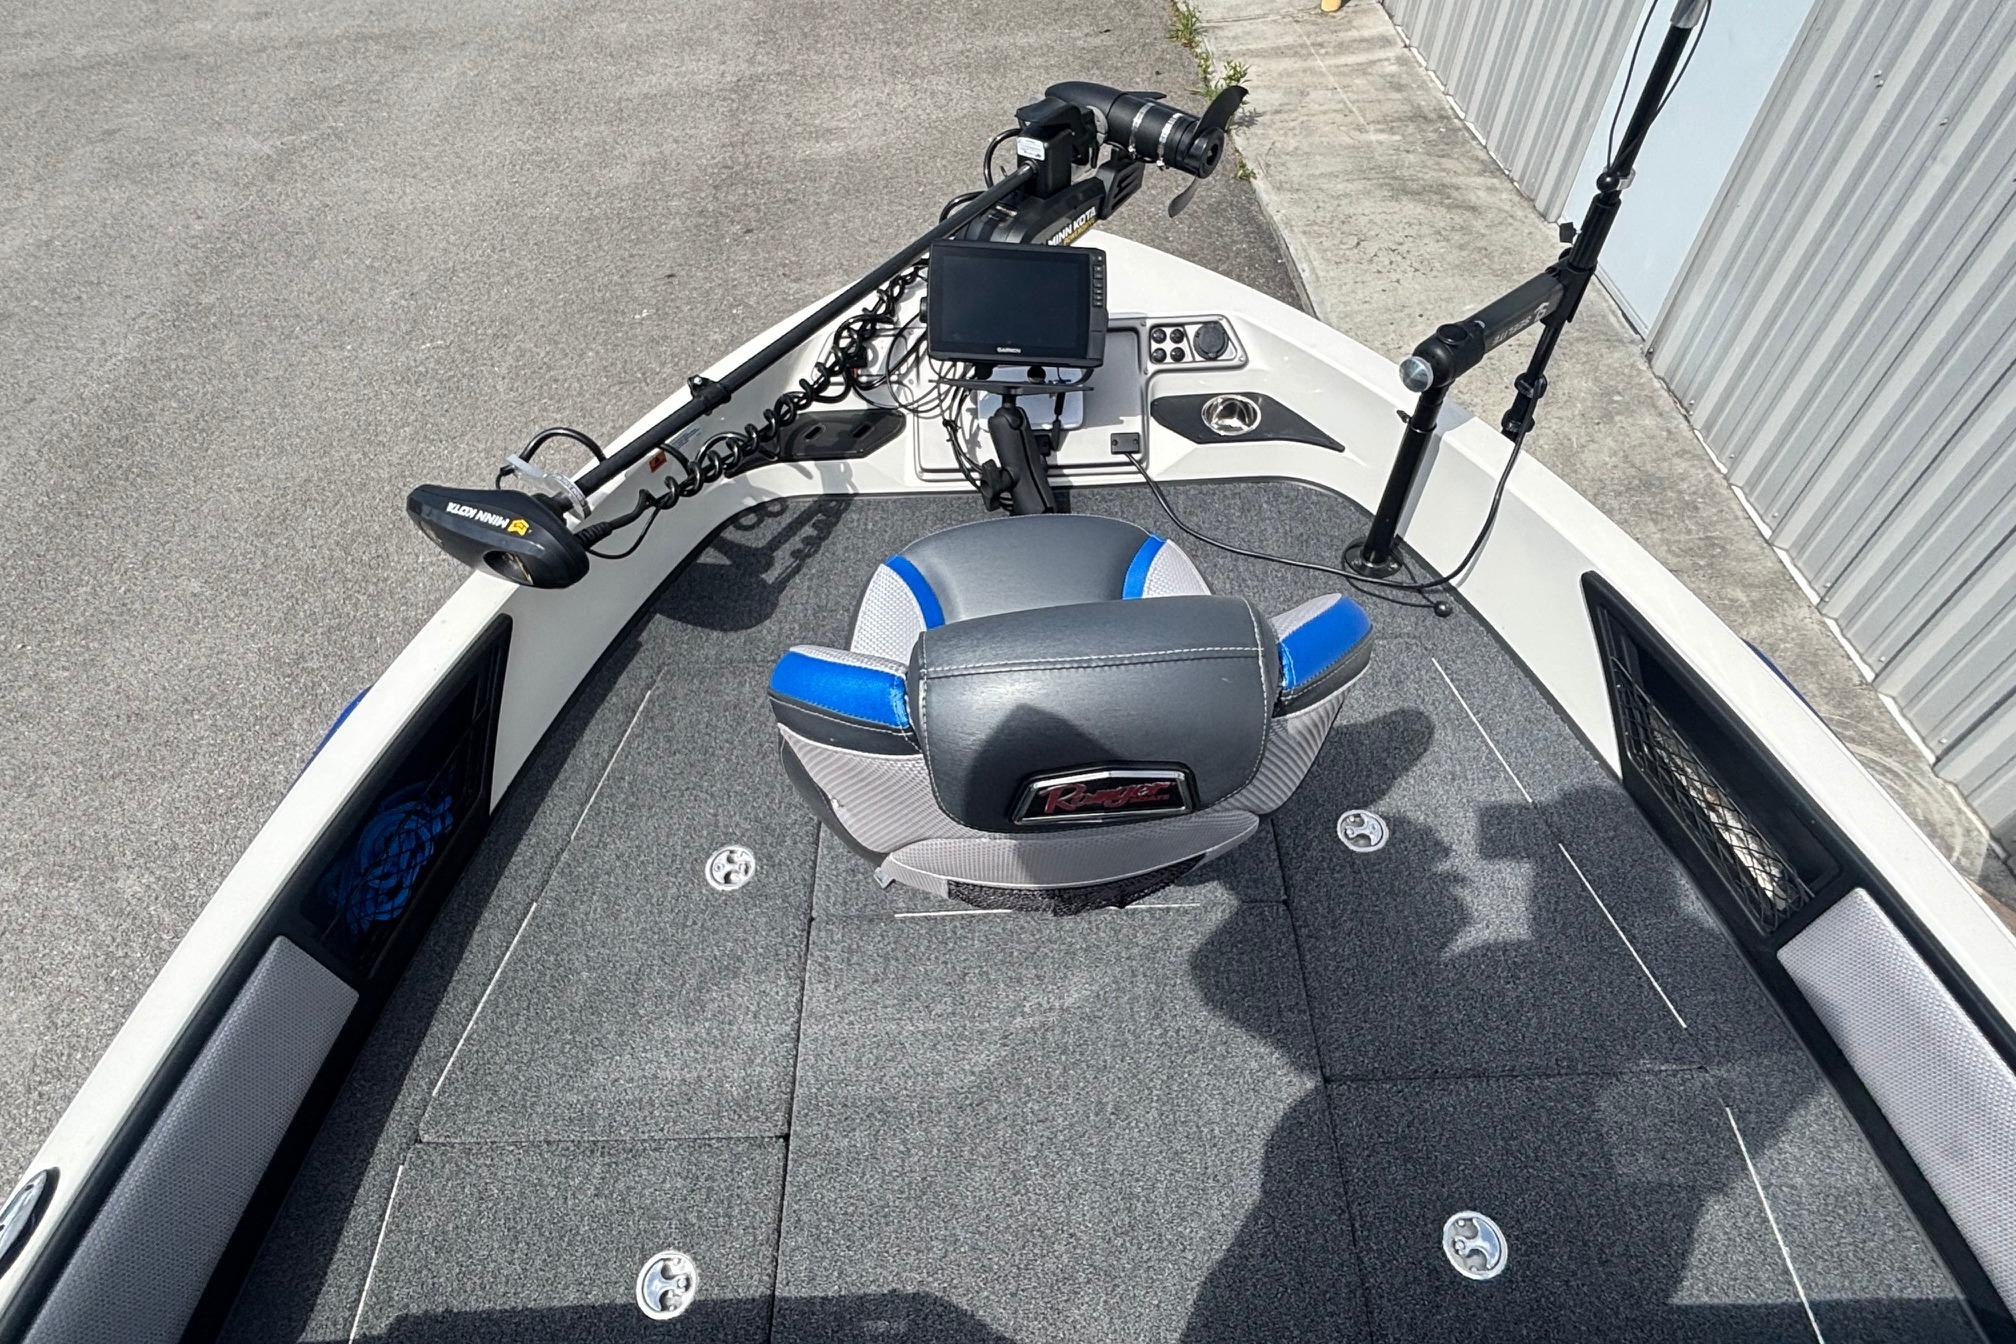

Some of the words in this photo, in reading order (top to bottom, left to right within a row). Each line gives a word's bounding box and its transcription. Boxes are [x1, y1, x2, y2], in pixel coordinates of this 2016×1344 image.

[1047, 223, 1073, 246] MINN
[1073, 206, 1096, 231] KOTA
[446, 501, 478, 519] KOTA
[474, 510, 510, 529] MINN
